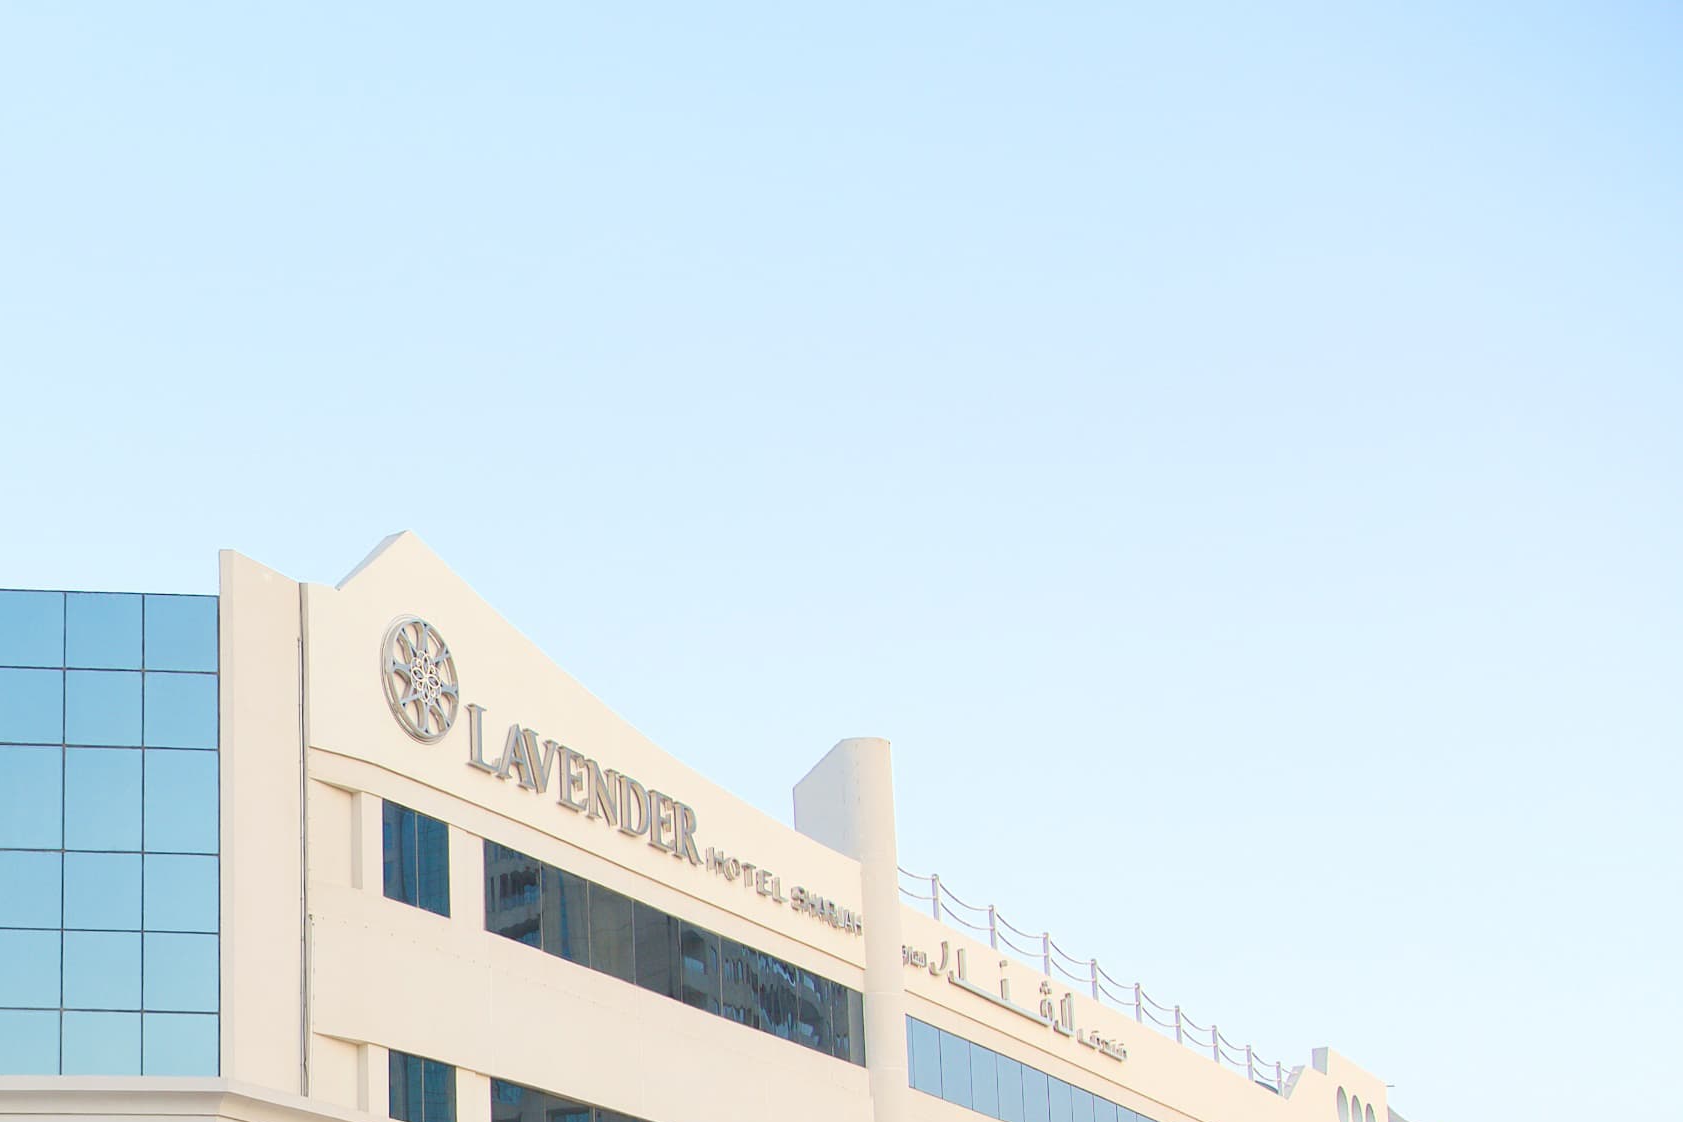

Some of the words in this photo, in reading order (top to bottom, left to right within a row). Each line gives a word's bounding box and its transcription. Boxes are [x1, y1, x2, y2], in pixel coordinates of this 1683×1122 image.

[464, 703, 704, 865] LAVENDER
[706, 846, 789, 904] HOTEL
[790, 886, 863, 936] SHARJAH
